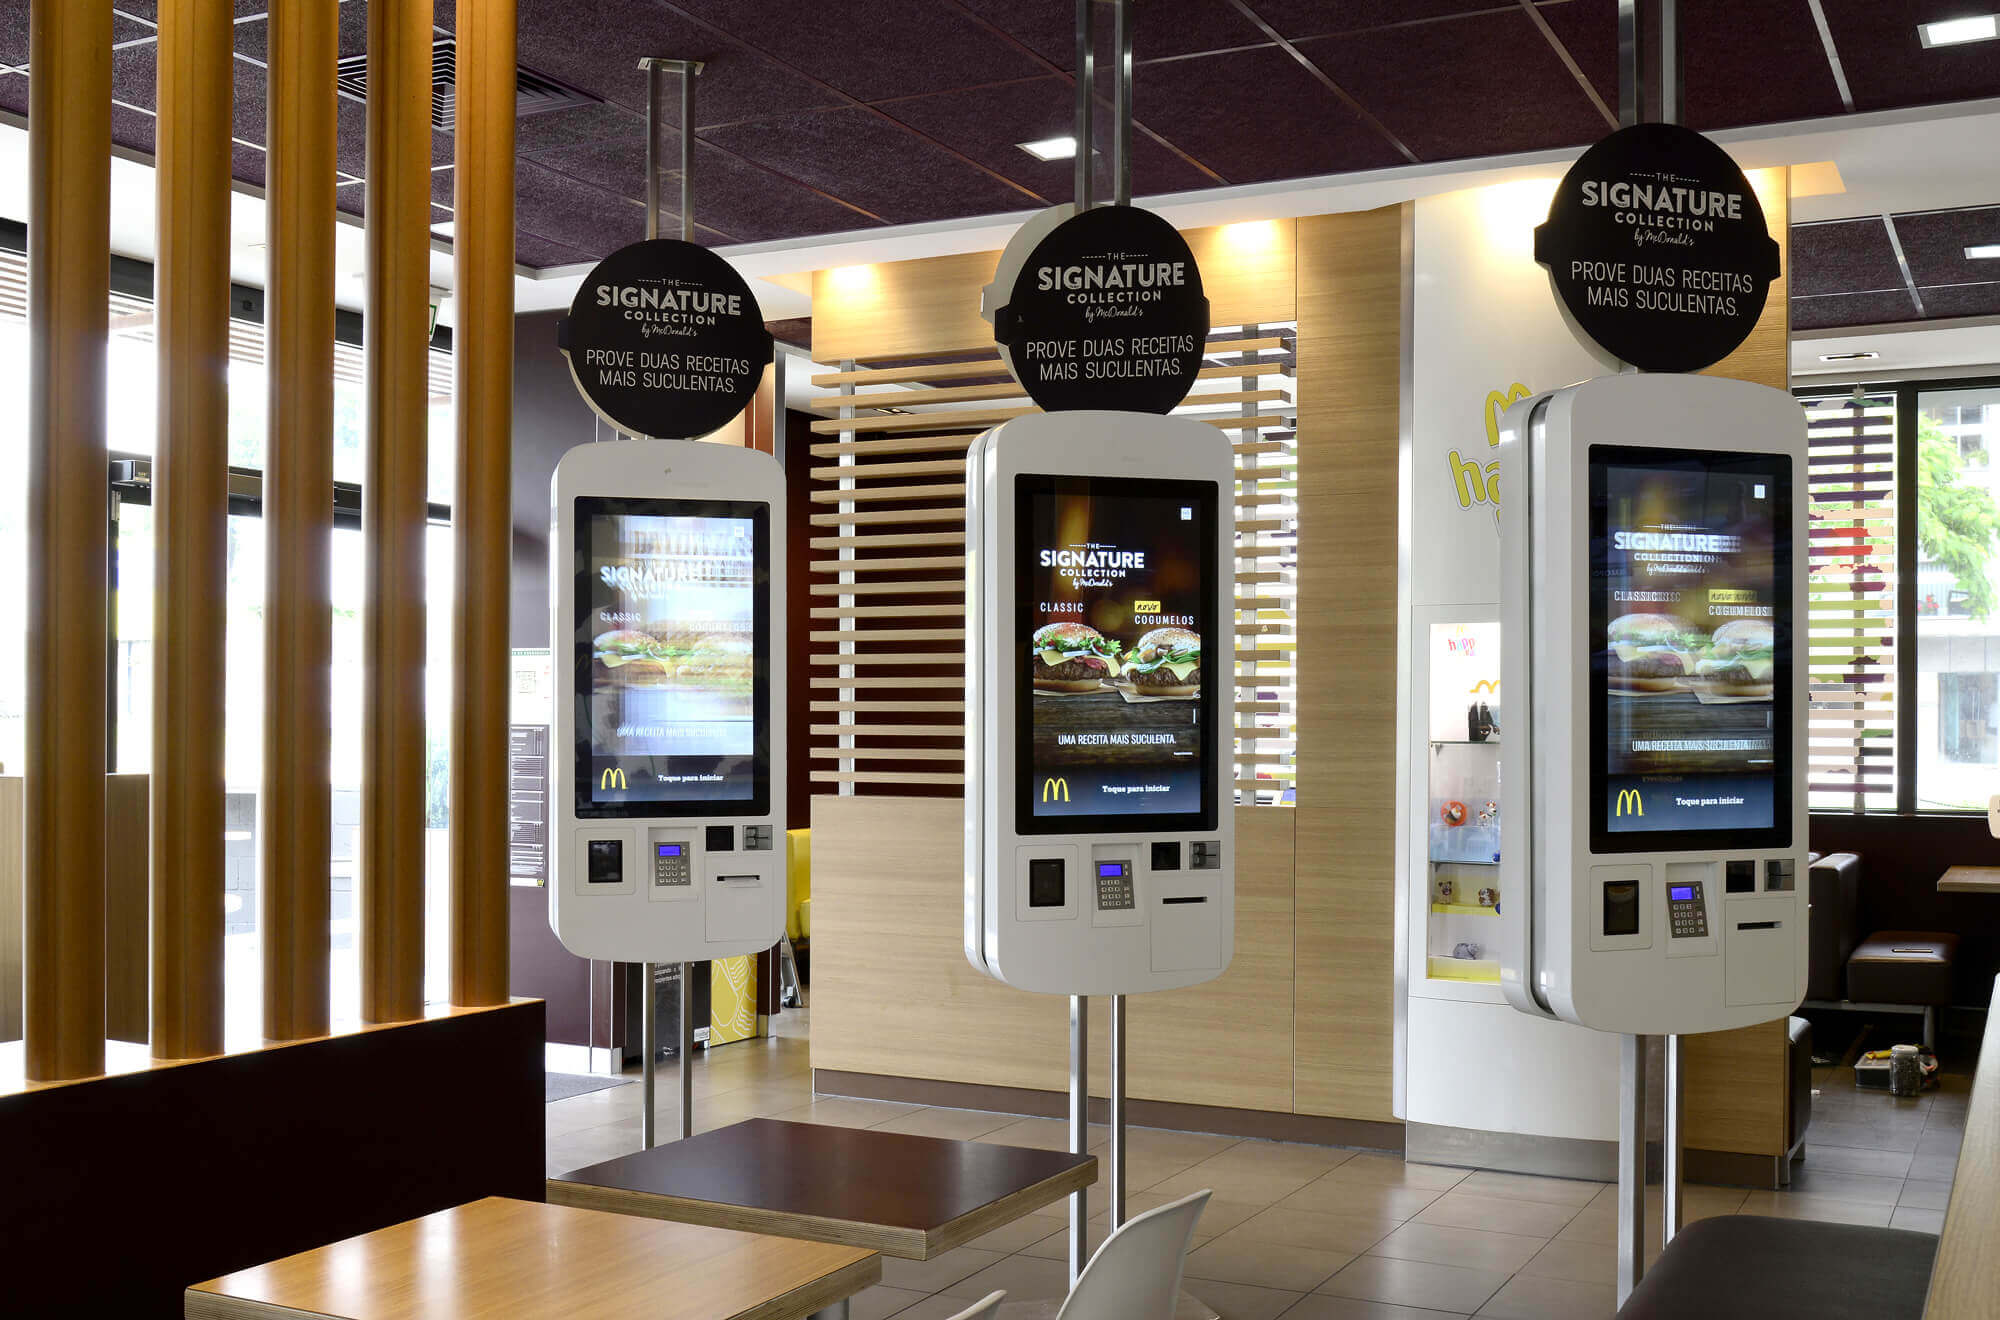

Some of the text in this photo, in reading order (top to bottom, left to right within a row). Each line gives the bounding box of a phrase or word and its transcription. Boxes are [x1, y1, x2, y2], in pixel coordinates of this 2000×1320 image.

[1656, 172, 1676, 183] THE
[1581, 180, 1742, 220] SIGNATURE
[1614, 211, 1714, 233] COLLECTION
[1634, 228, 1695, 247] by McDonald's
[1107, 252, 1126, 261] THE
[662, 278, 680, 287] THE
[1037, 262, 1185, 291] SIGNATURE
[1571, 261, 1753, 294] PROVE DUAS RECEITAS
[596, 285, 741, 316] SIGNATURE
[1066, 290, 1162, 305] COLLECTION
[1587, 286, 1740, 317] MAIS SUCULENTAS.
[624, 310, 716, 325] COLLECTION
[1085, 305, 1144, 324] by McDonald's
[641, 322, 698, 338] by McDonald's
[1026, 334, 1194, 359] PROVE DUAS RECEITAS
[586, 350, 749, 375] PROVE DUAS RECEITAS
[1040, 358, 1183, 381] MAIS SUCULENTAS.
[599, 370, 737, 394] MAIS SUCULENTAS.
[1614, 531, 1724, 552] SIGNATURE
[1040, 550, 1145, 569] SIGNATURE
[1060, 568, 1126, 578] COLLECTION
[1040, 602, 1084, 613] CLASSIC
[600, 611, 641, 623] CLASSIC
[1134, 615, 1194, 625] COGUMELOS
[1058, 734, 1177, 745] UMA RECEITA MAIS SUCULENTA.
[658, 774, 724, 783] Toque para iniciar
[1102, 785, 1126, 794] Toque
[1127, 786, 1144, 794] para
[1676, 796, 1744, 807] Toque para iniciar
